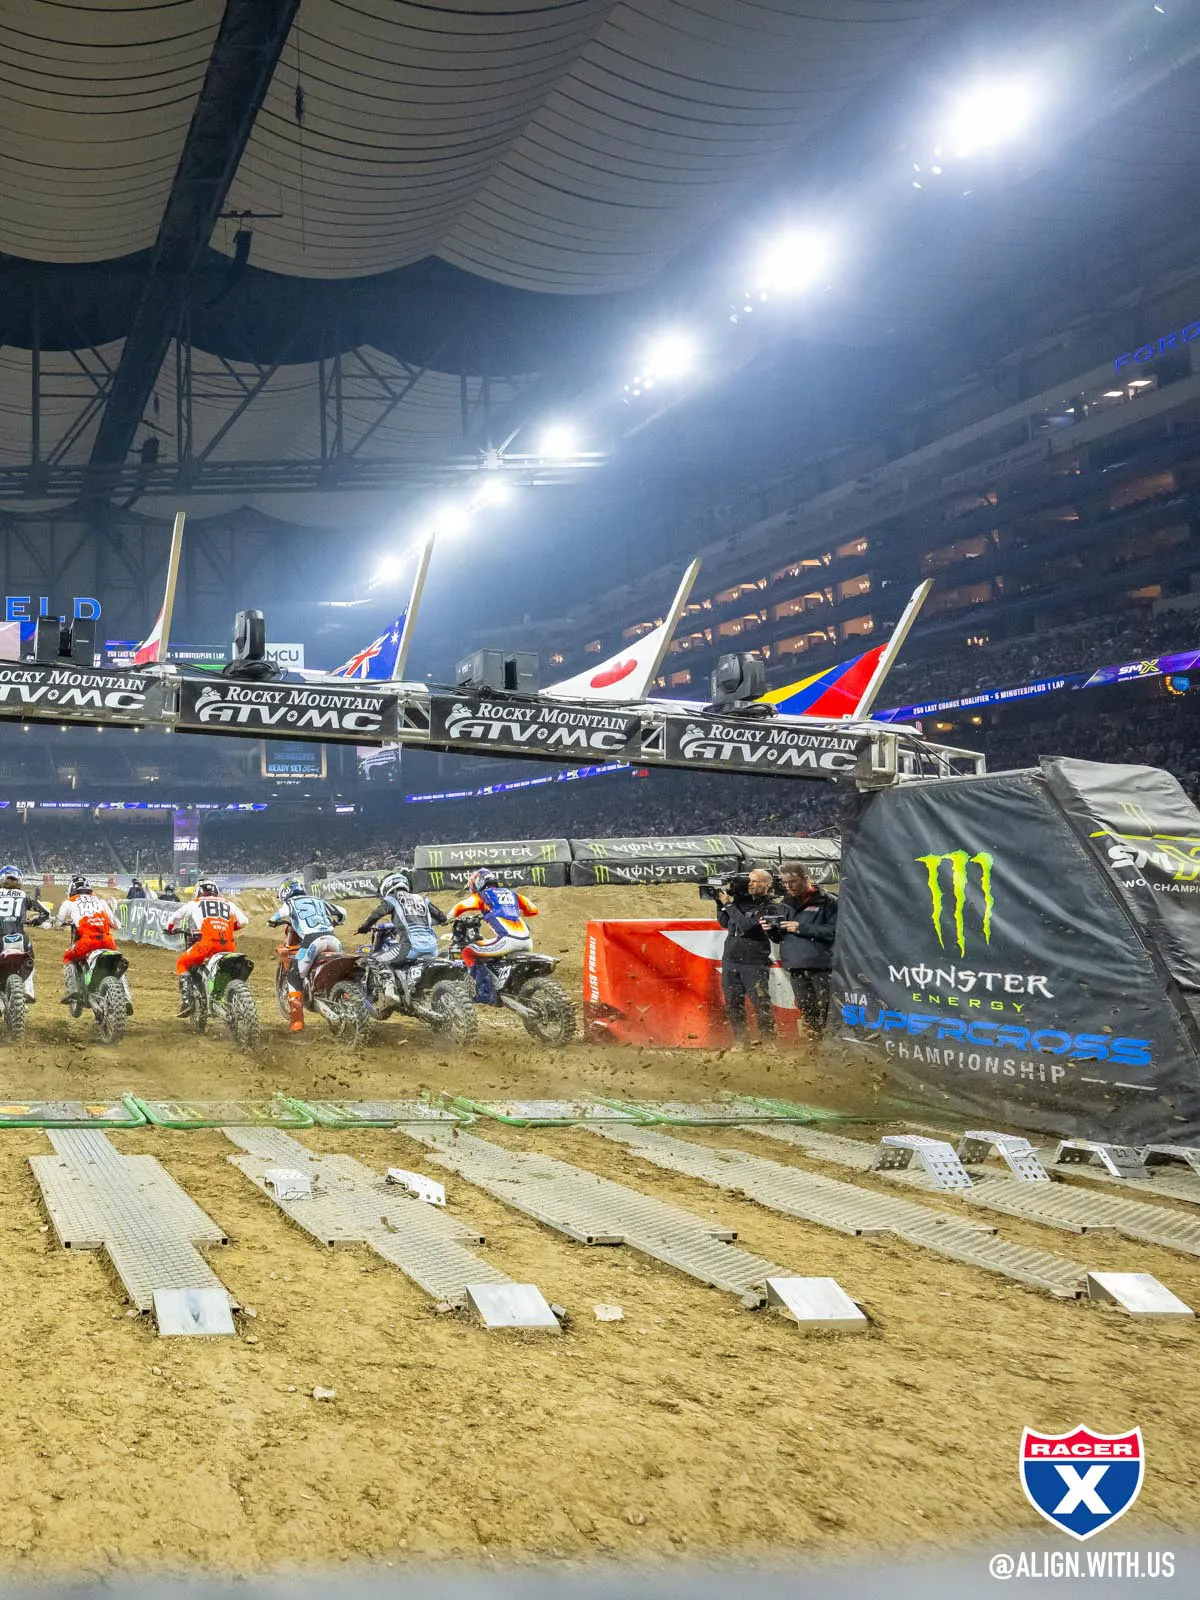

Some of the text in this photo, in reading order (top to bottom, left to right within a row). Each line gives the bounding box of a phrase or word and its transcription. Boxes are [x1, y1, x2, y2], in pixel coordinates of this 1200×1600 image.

[1118, 659, 1159, 675] SMX
[48, 671, 146, 691] MOUNTAIN
[225, 686, 383, 711] ROCKY MOUNTAIN
[925, 705, 937, 713] LAST
[960, 694, 990, 706] QUALIFIER
[1000, 684, 1046, 699] MINUTES/PLUS
[1052, 680, 1065, 690] LAP
[476, 702, 629, 731] ROCKY MOUNTAIN
[708, 724, 858, 751] ROCKY MOUNTAIN
[450, 847, 533, 860] MONSTER
[613, 840, 698, 853] MONSTER
[616, 864, 698, 877] MONSTER
[323, 879, 374, 892] MONSTER
[198, 900, 231, 920] 188
[888, 963, 1055, 999] MONSTER
[844, 992, 868, 1006] AMA
[912, 993, 1025, 1013] ENERGY
[841, 1005, 1152, 1067] SUPERCROSS
[884, 1040, 1066, 1084] CHAMPIONSHIP
